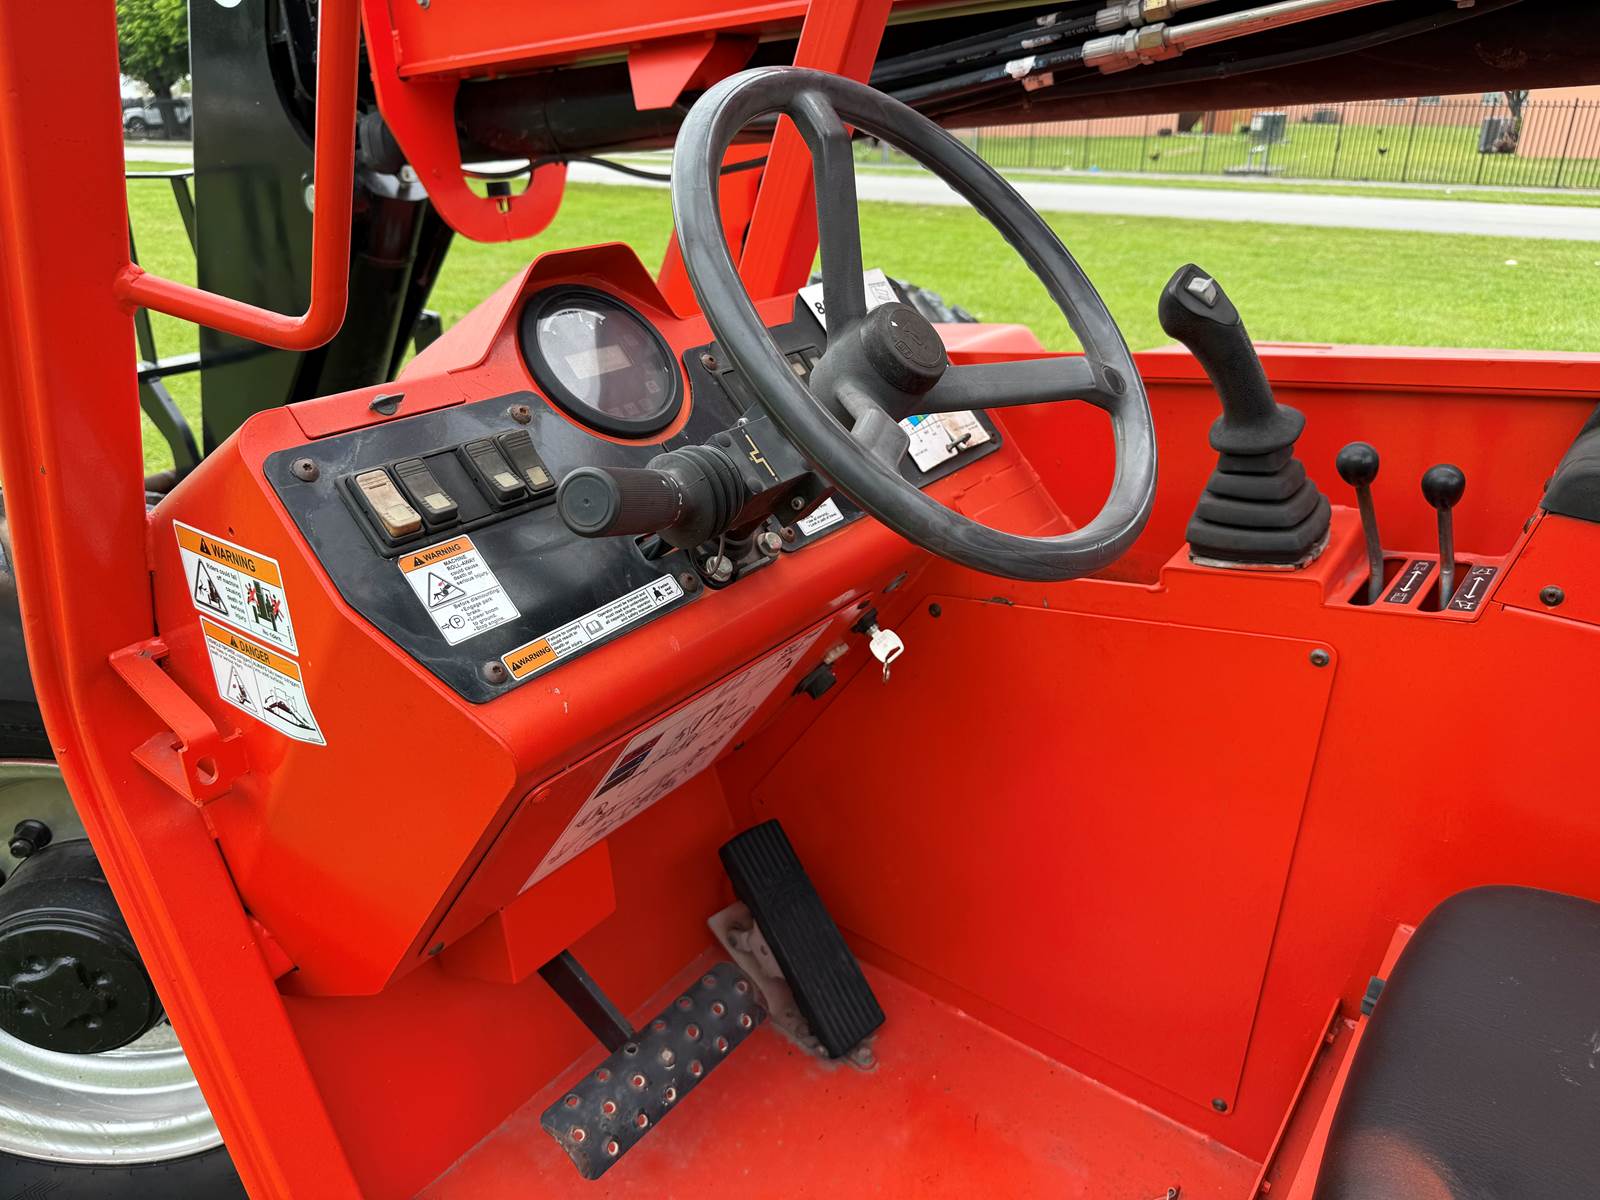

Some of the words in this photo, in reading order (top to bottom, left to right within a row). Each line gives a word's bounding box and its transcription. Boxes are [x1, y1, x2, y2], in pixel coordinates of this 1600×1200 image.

[212, 543, 256, 573] WARNING
[423, 544, 461, 561] WARNING
[443, 555, 467, 566] MACHINE
[447, 558, 476, 571] ROLL-AWAY
[450, 568, 464, 576] could
[465, 563, 478, 572] cause
[453, 572, 467, 580] death
[457, 577, 474, 585] serious
[597, 608, 613, 617] Operator
[239, 640, 270, 664] DANGER
[518, 646, 550, 666] WARNING
[557, 646, 571, 655] serious
